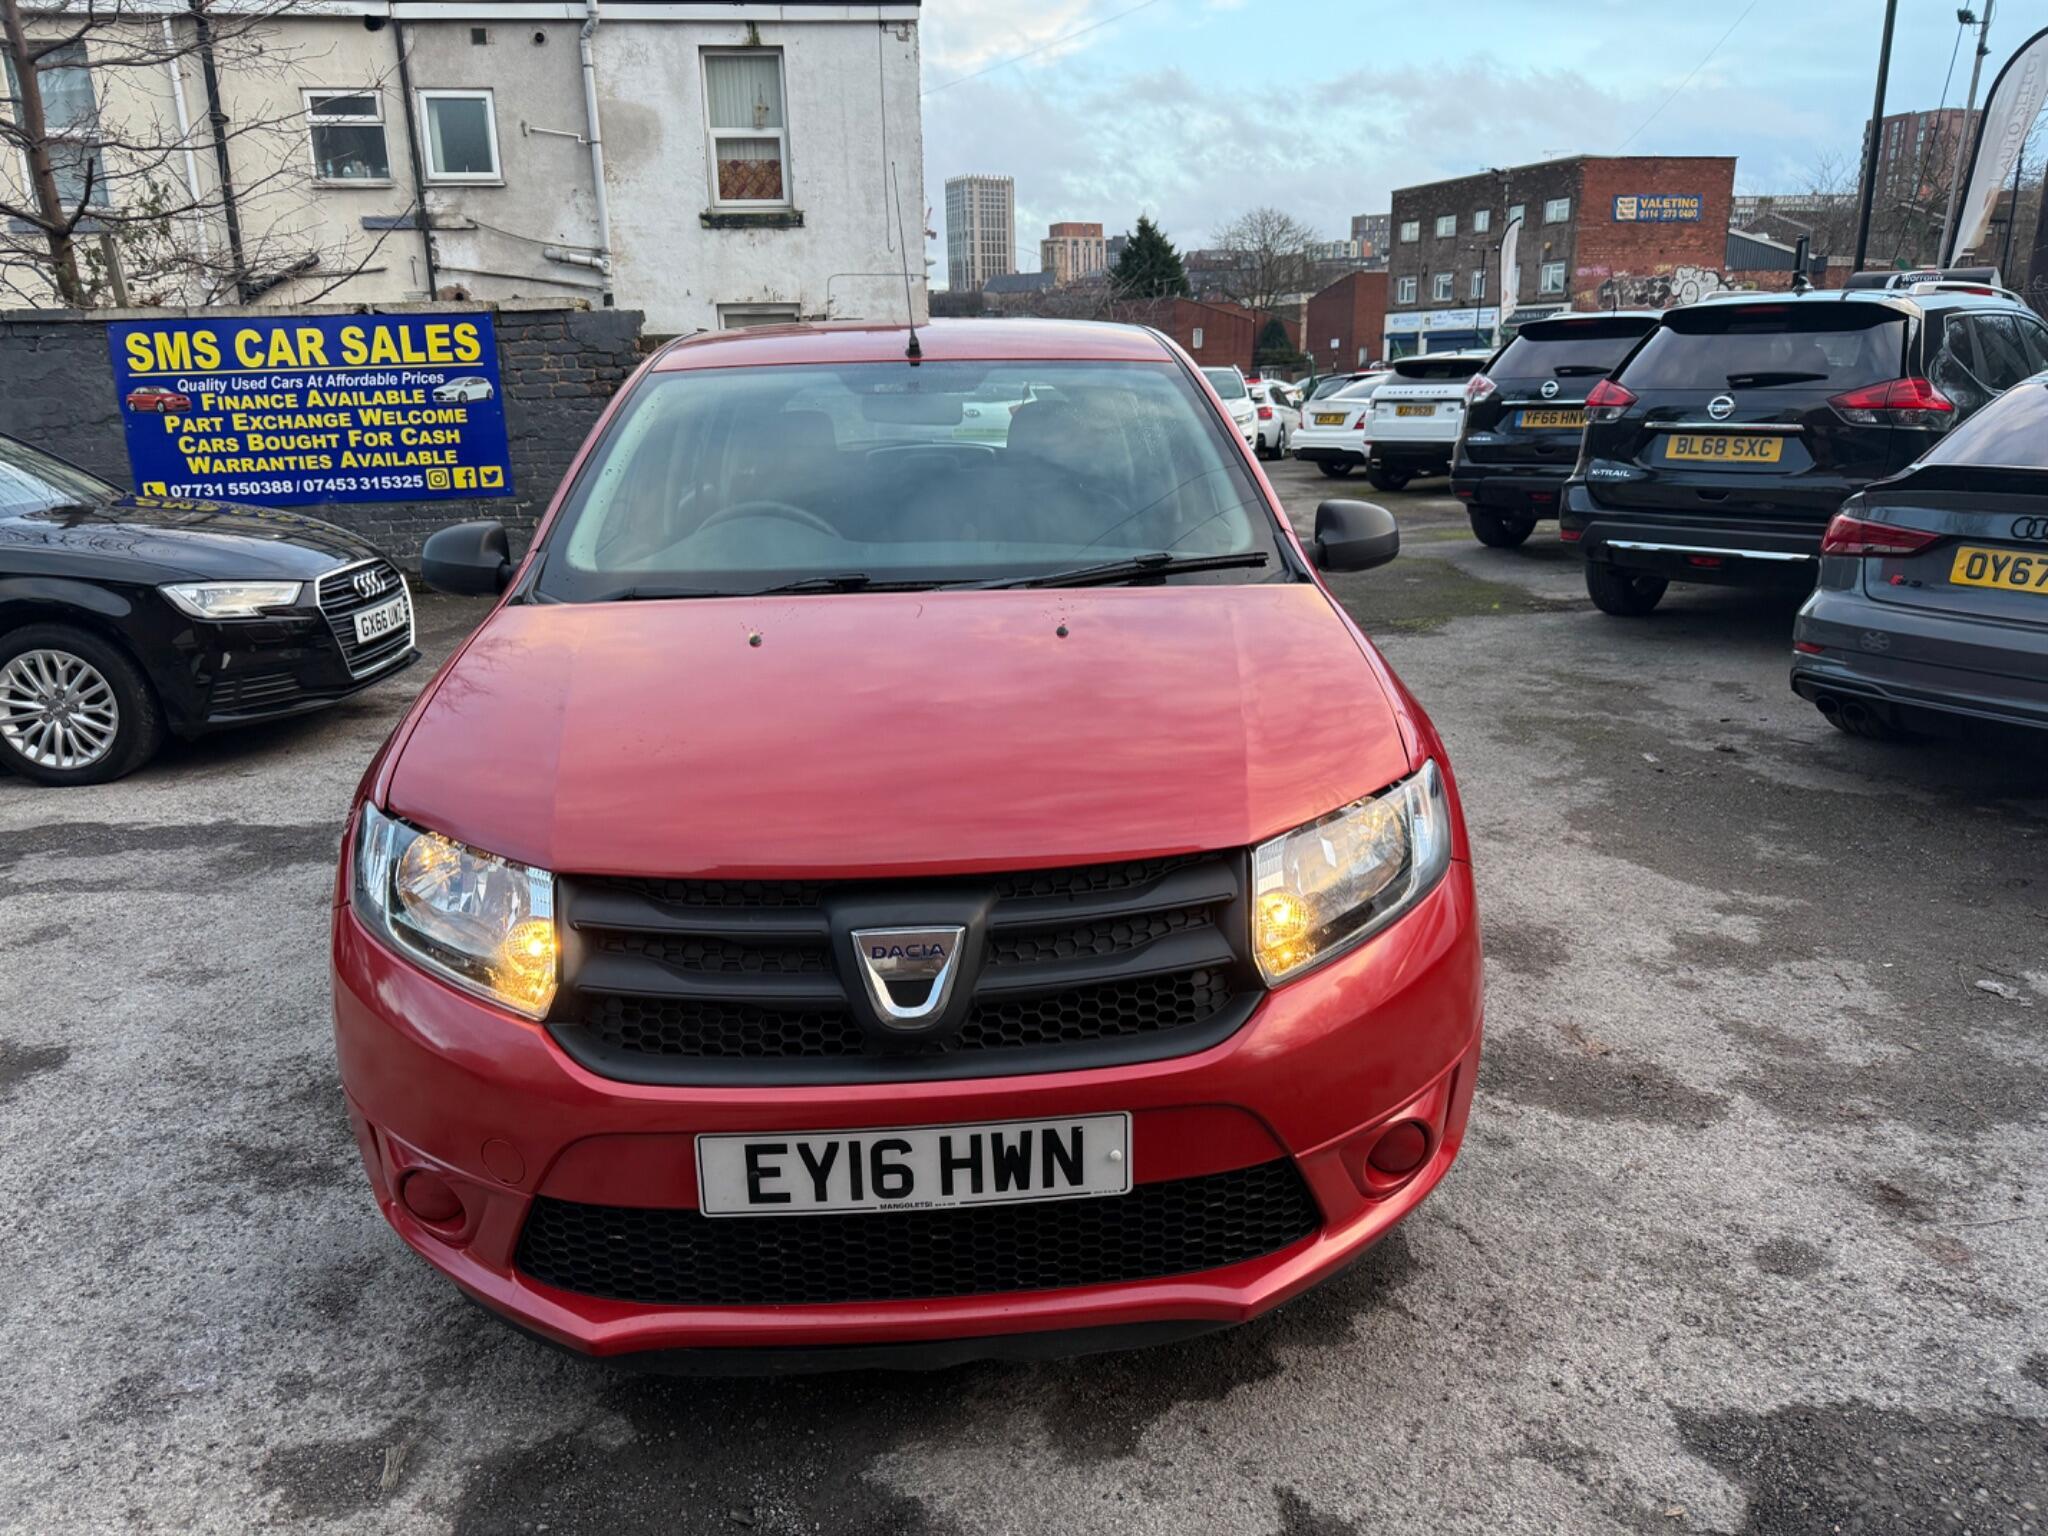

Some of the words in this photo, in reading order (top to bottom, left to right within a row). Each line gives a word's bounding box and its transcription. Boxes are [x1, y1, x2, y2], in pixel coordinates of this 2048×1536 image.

[1640, 198, 1699, 208] VALETING
[125, 329, 221, 372] SMS
[234, 327, 330, 369] CAR
[340, 322, 481, 365] SALES
[177, 378, 228, 395] Quality
[231, 376, 267, 390] Used
[271, 375, 303, 389] Cars
[307, 374, 323, 388] At
[325, 371, 398, 388] Affordable
[401, 370, 444, 385] Prices
[201, 392, 299, 411] FINANCE
[306, 388, 426, 408] AVAILABLE
[164, 415, 224, 434] PART
[231, 412, 352, 432] EXCHANGE
[357, 408, 468, 427] WELCOME
[1525, 410, 1559, 425] YF66
[178, 435, 239, 454] CARS
[246, 433, 340, 452] BOUGHT
[348, 429, 394, 448] FOR
[401, 427, 461, 446] CASH
[1674, 437, 1728, 456] BL68
[1732, 438, 1773, 457] SXC
[186, 454, 333, 475] WARRANTIES
[340, 450, 458, 469] AVAILABLE
[1591, 468, 1631, 478] X-TRAIL
[170, 482, 224, 498] 07731
[228, 481, 293, 496] 550388
[303, 478, 358, 493] 07453
[360, 475, 424, 491] 315325
[361, 610, 388, 637] GX66
[871, 943, 946, 961] DACIA
[744, 1138, 914, 1204] EY16
[939, 1126, 1084, 1196] HWN
